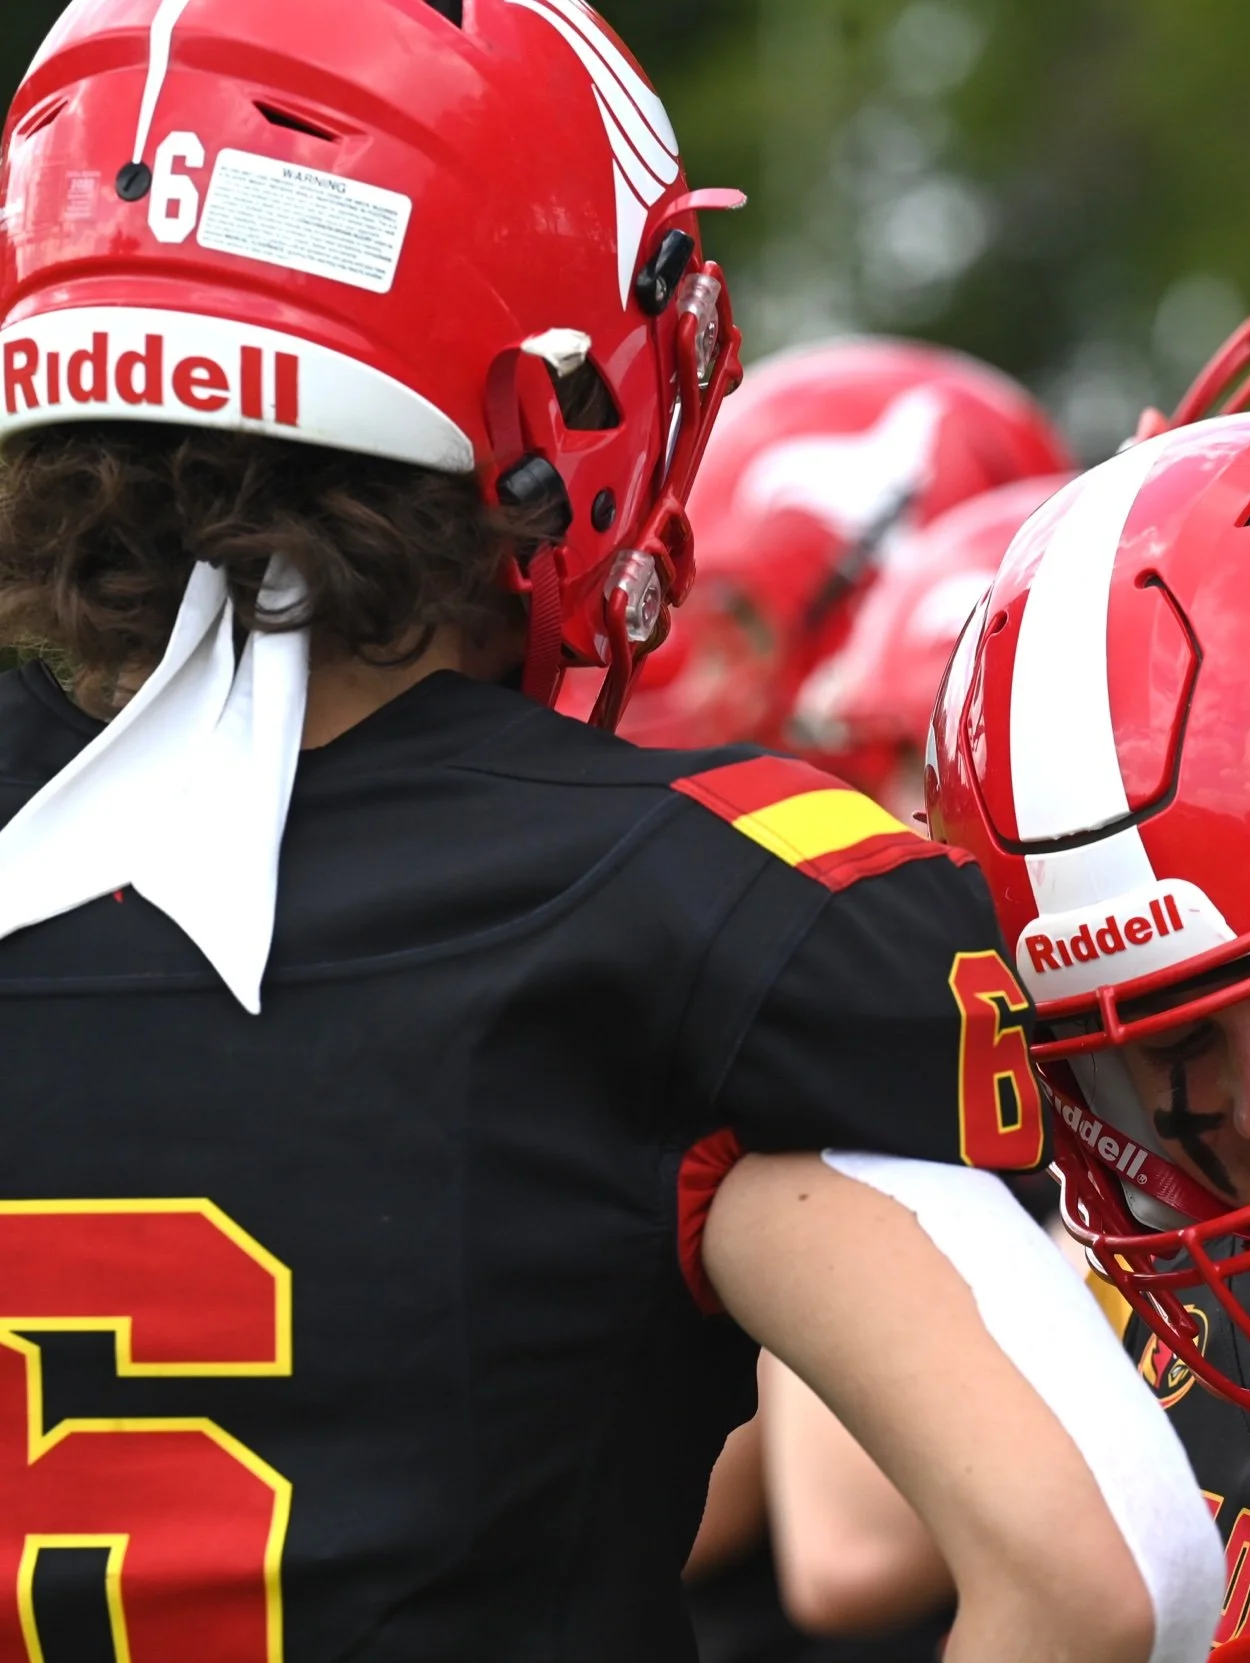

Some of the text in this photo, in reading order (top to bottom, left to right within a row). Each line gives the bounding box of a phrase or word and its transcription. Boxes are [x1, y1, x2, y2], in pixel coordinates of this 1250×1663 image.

[148, 131, 205, 244] 6
[282, 167, 347, 194] WARNING
[3, 331, 300, 427] Riddell
[1025, 894, 1184, 973] Riddell
[948, 949, 1044, 1169] 6
[0, 1197, 292, 1663] 6
